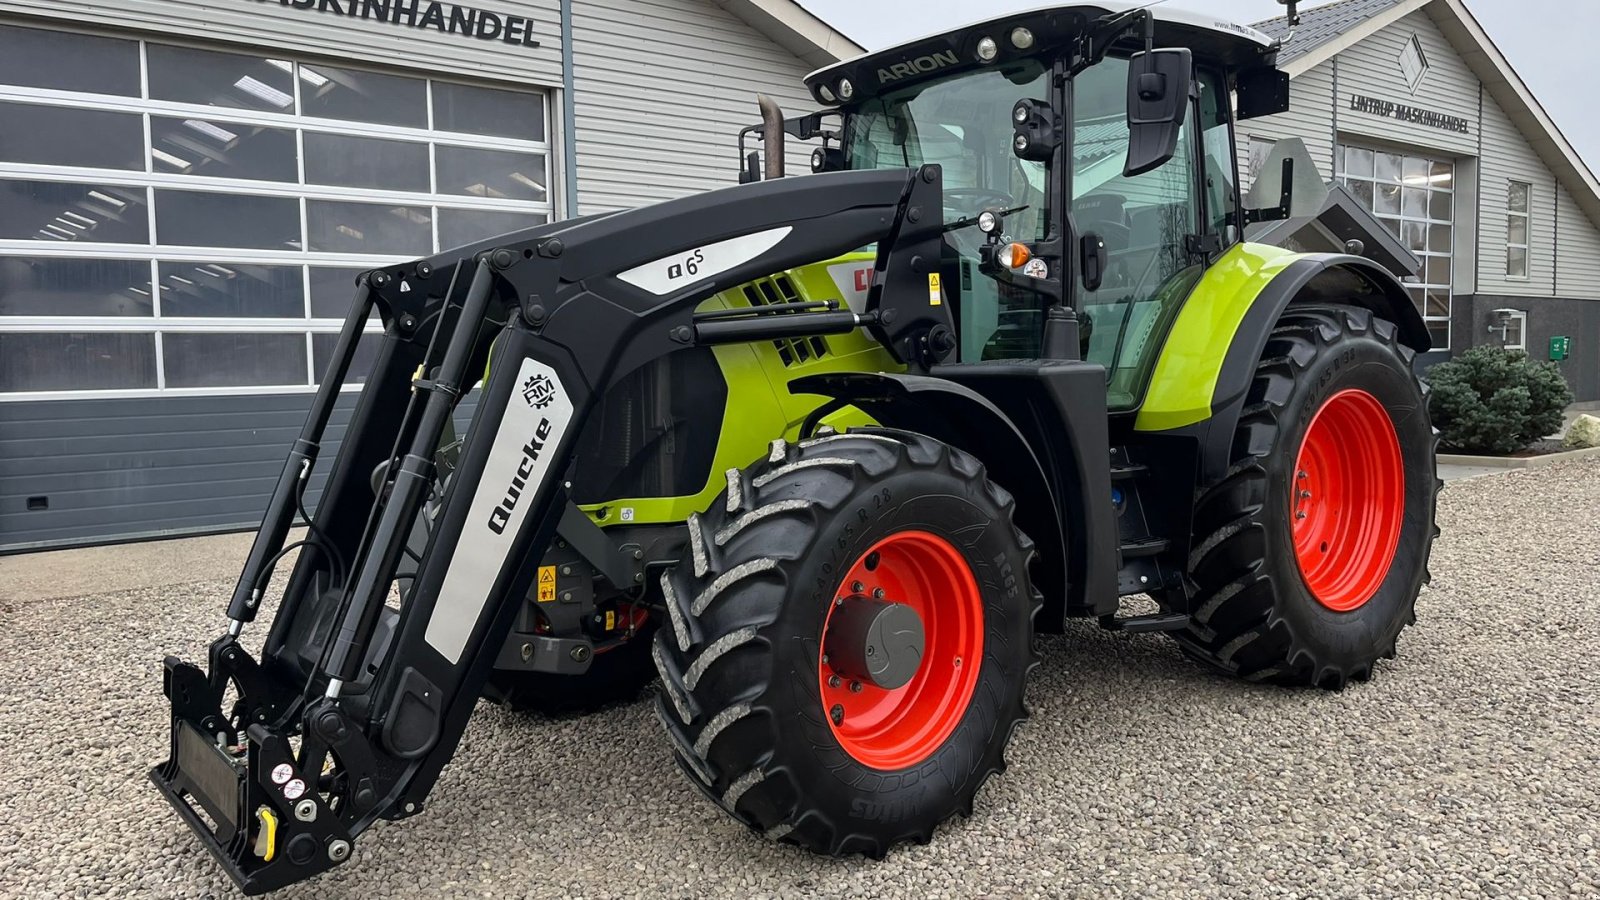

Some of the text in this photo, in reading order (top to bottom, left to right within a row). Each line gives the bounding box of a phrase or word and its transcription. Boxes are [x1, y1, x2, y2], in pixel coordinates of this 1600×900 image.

[877, 49, 960, 84] ARION
[1350, 94, 1469, 134] LINTRUP MASKINHANDEL
[523, 379, 556, 406] RM
[487, 417, 552, 536] Quicke
[857, 507, 869, 524] R
[873, 487, 892, 510] 28
